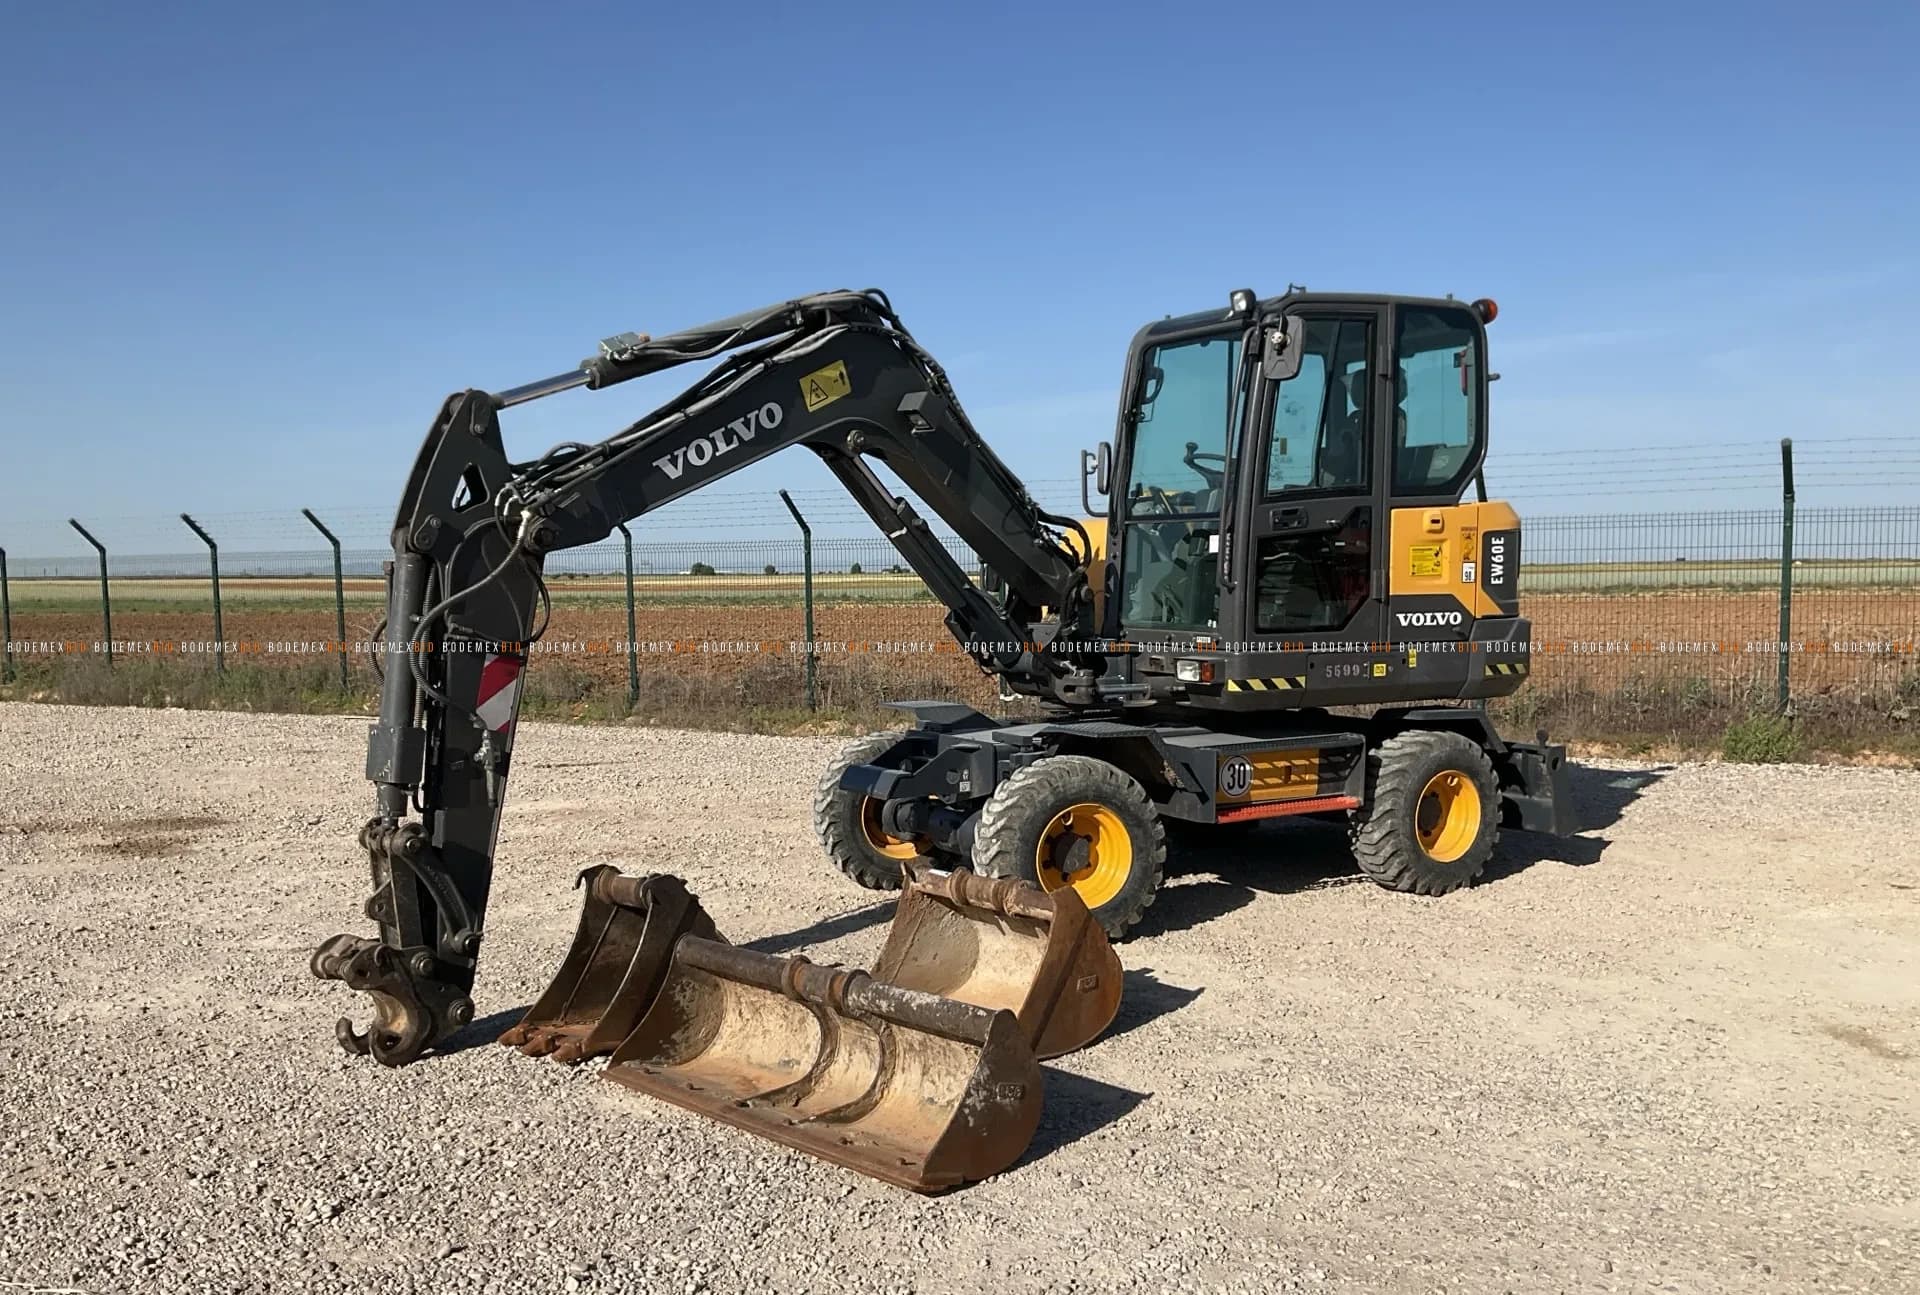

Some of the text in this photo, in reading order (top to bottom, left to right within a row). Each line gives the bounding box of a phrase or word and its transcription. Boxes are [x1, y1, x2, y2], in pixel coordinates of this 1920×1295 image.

[652, 401, 783, 480] VOLVO
[1490, 536, 1504, 585] EW60E
[1396, 611, 1462, 627] VOLVO
[1226, 762, 1247, 790] 30
